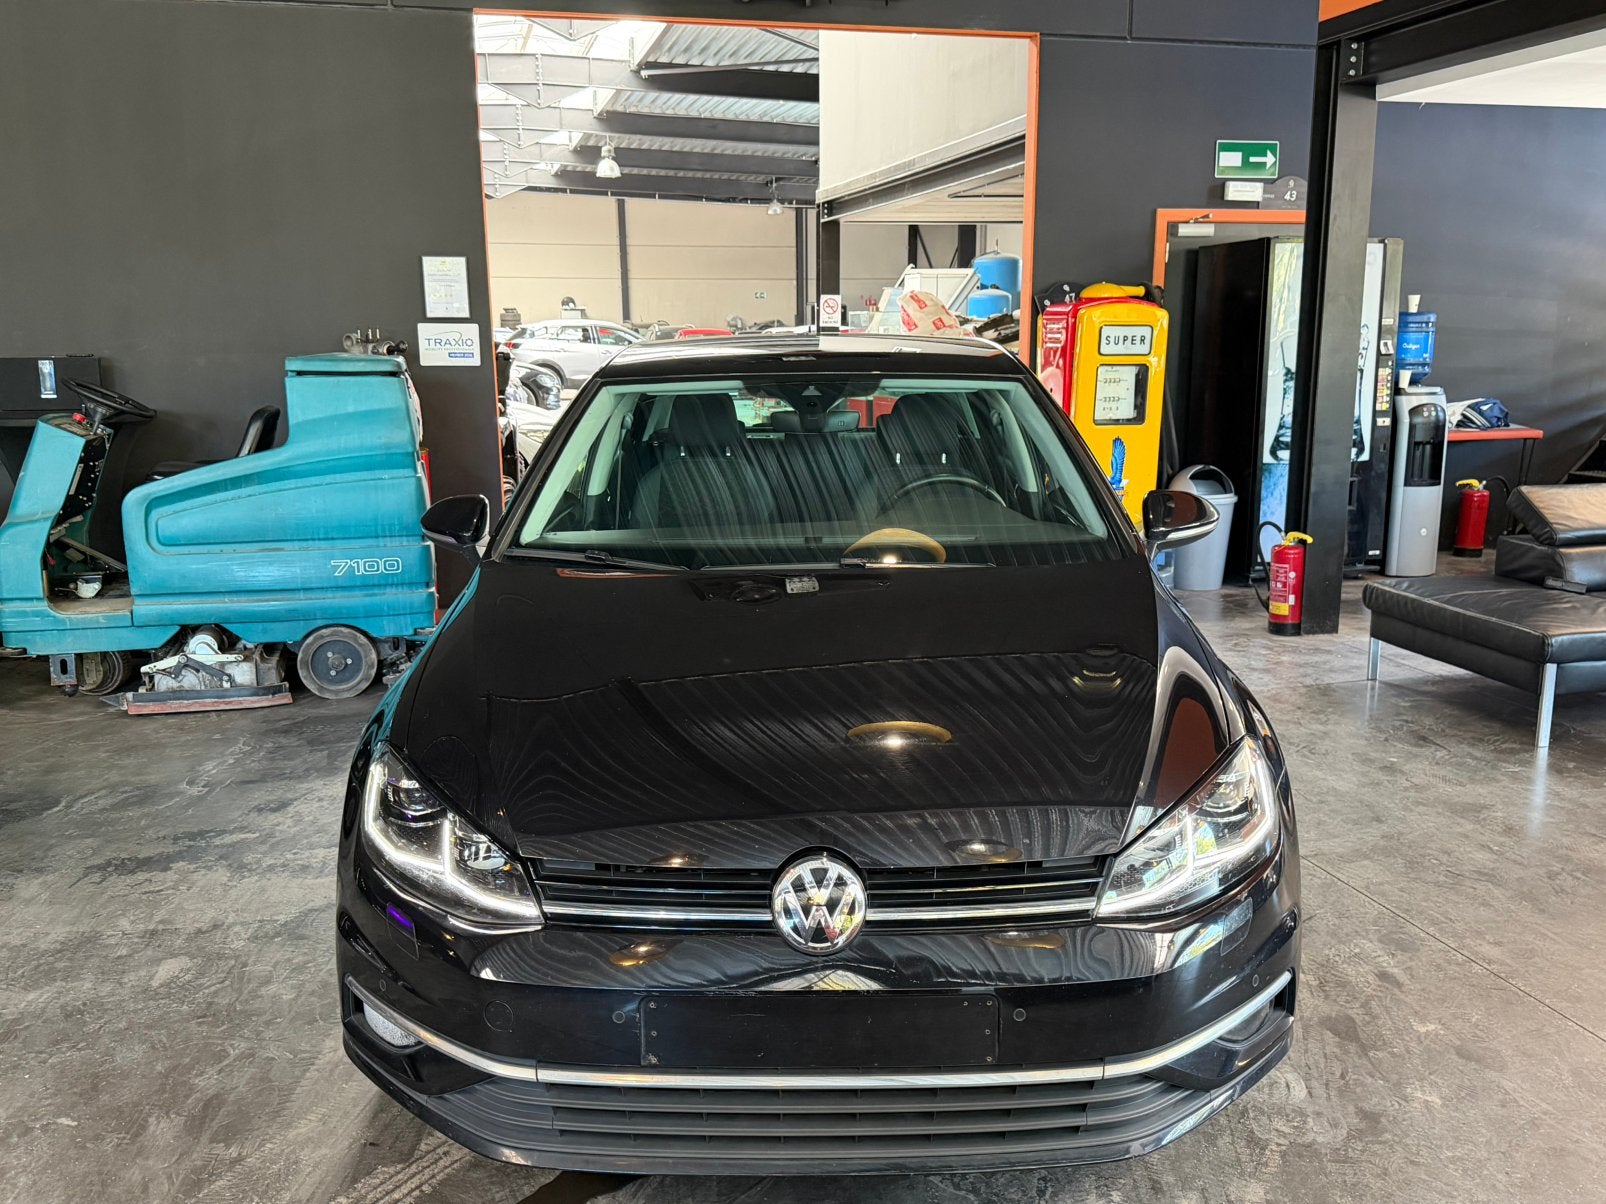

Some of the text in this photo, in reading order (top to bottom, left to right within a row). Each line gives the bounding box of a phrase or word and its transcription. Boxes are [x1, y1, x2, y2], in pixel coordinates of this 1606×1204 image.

[1284, 190, 1297, 201] 43
[1064, 293, 1076, 304] 47
[425, 338, 475, 347] TRAXIO
[1105, 335, 1146, 346] SUPER
[331, 557, 402, 576] 7100
